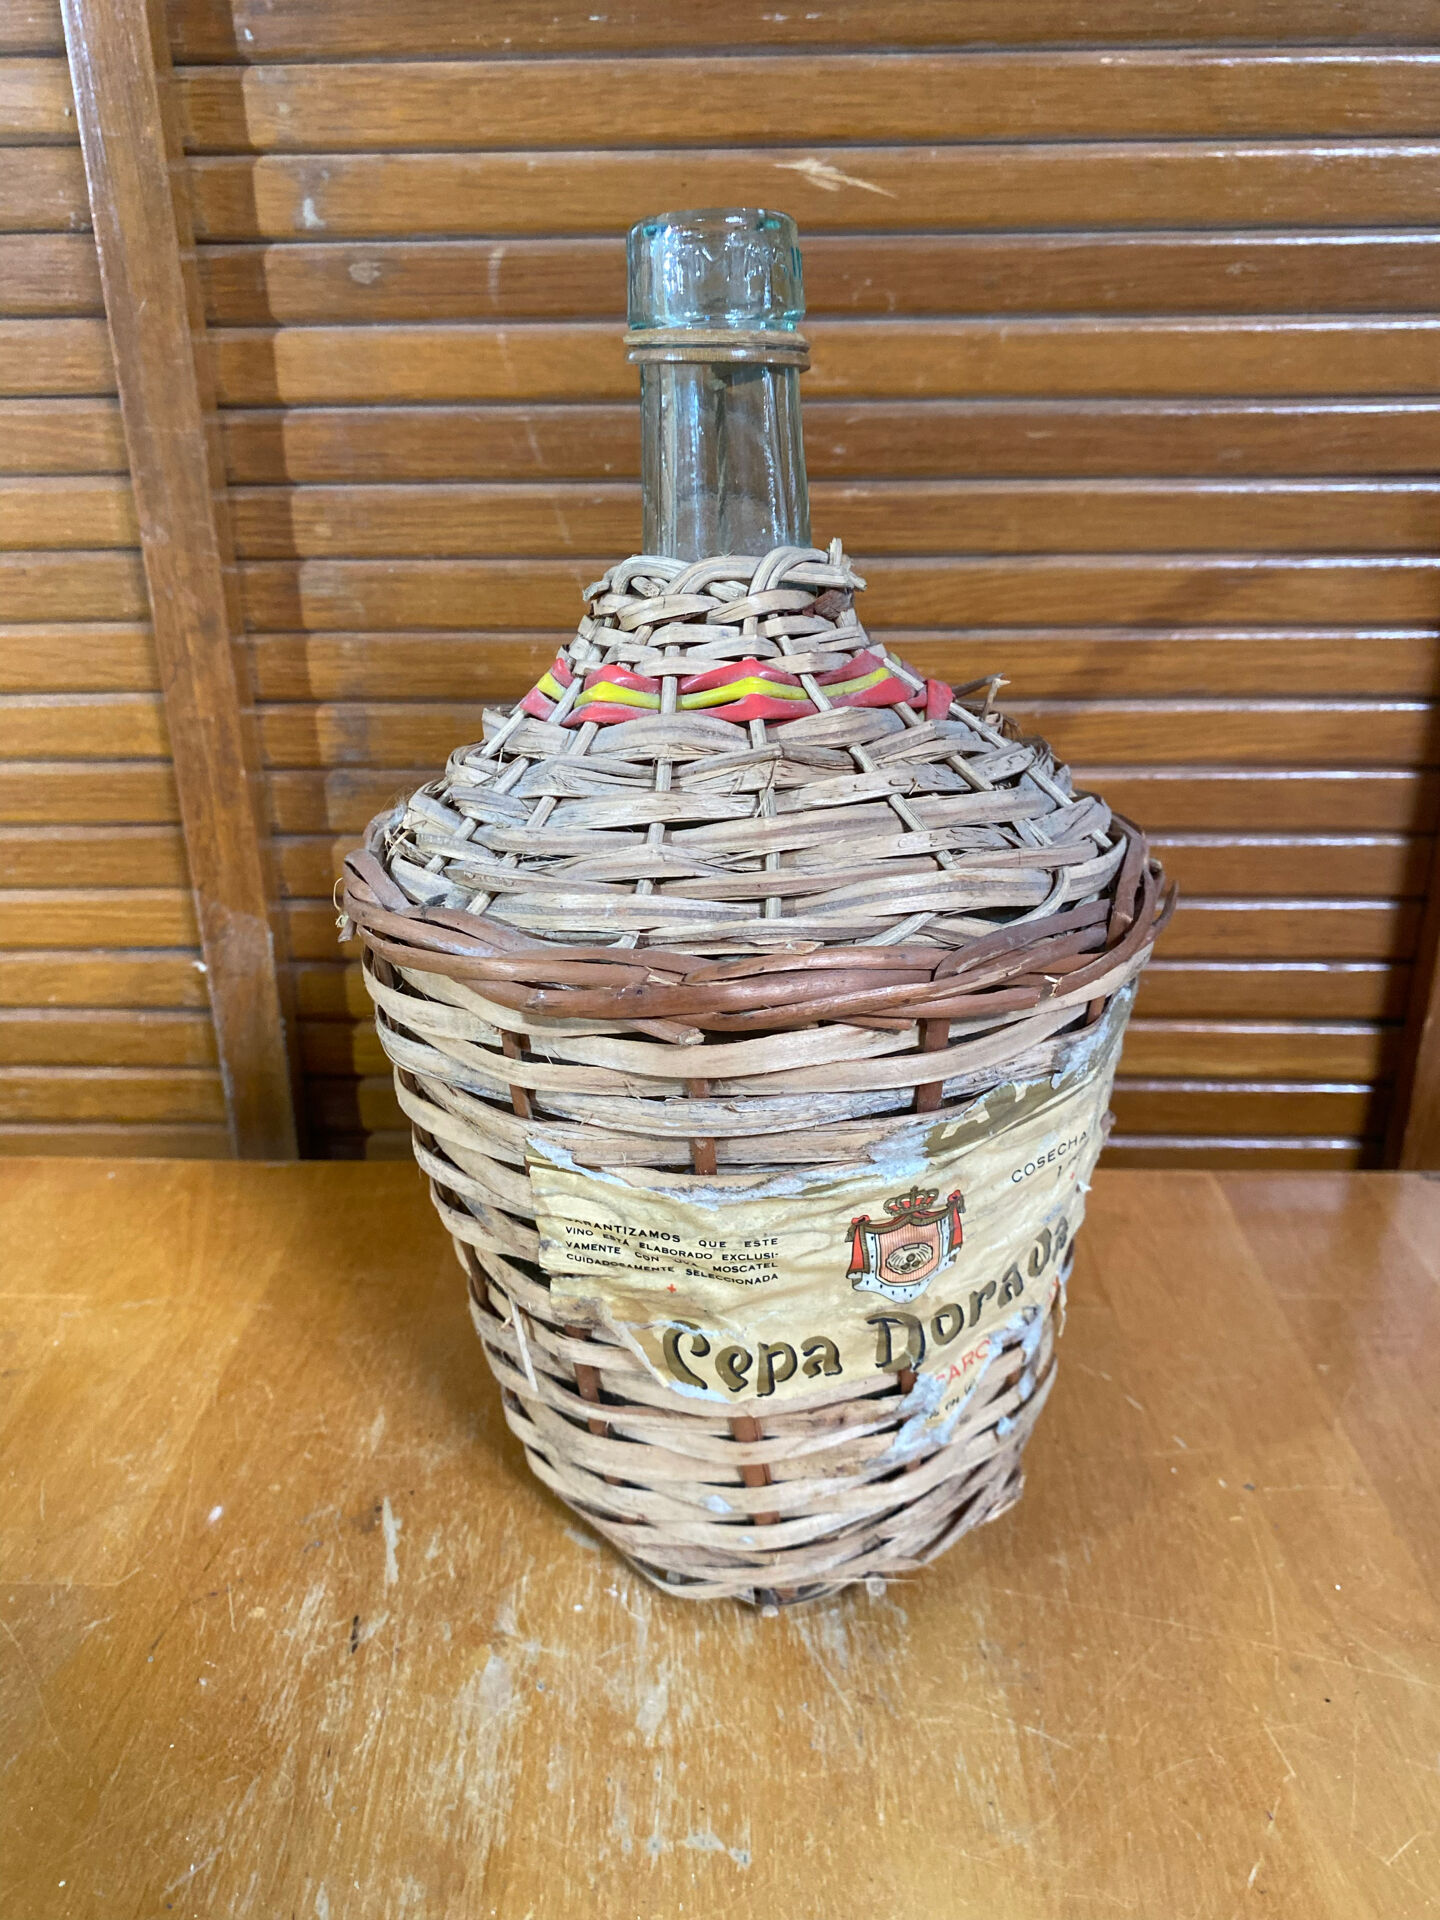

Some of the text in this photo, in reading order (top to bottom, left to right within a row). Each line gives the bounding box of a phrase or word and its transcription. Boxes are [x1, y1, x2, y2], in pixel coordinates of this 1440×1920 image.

[1012, 1131, 1087, 1183] COSECHA
[565, 1226, 594, 1236] VINO
[639, 1241, 713, 1260] ELABORADO
[721, 1252, 779, 1261] EXCLUSI-
[565, 1240, 622, 1255] VAMENTE
[634, 1251, 660, 1262] CON
[712, 1262, 779, 1273] MOSCATEL
[698, 1239, 727, 1248] QUE
[744, 1238, 779, 1248] ESTE
[566, 1253, 779, 1285] CUIDADOSAMENTE SELECCIONADA
[662, 1319, 844, 1397] Cepa
